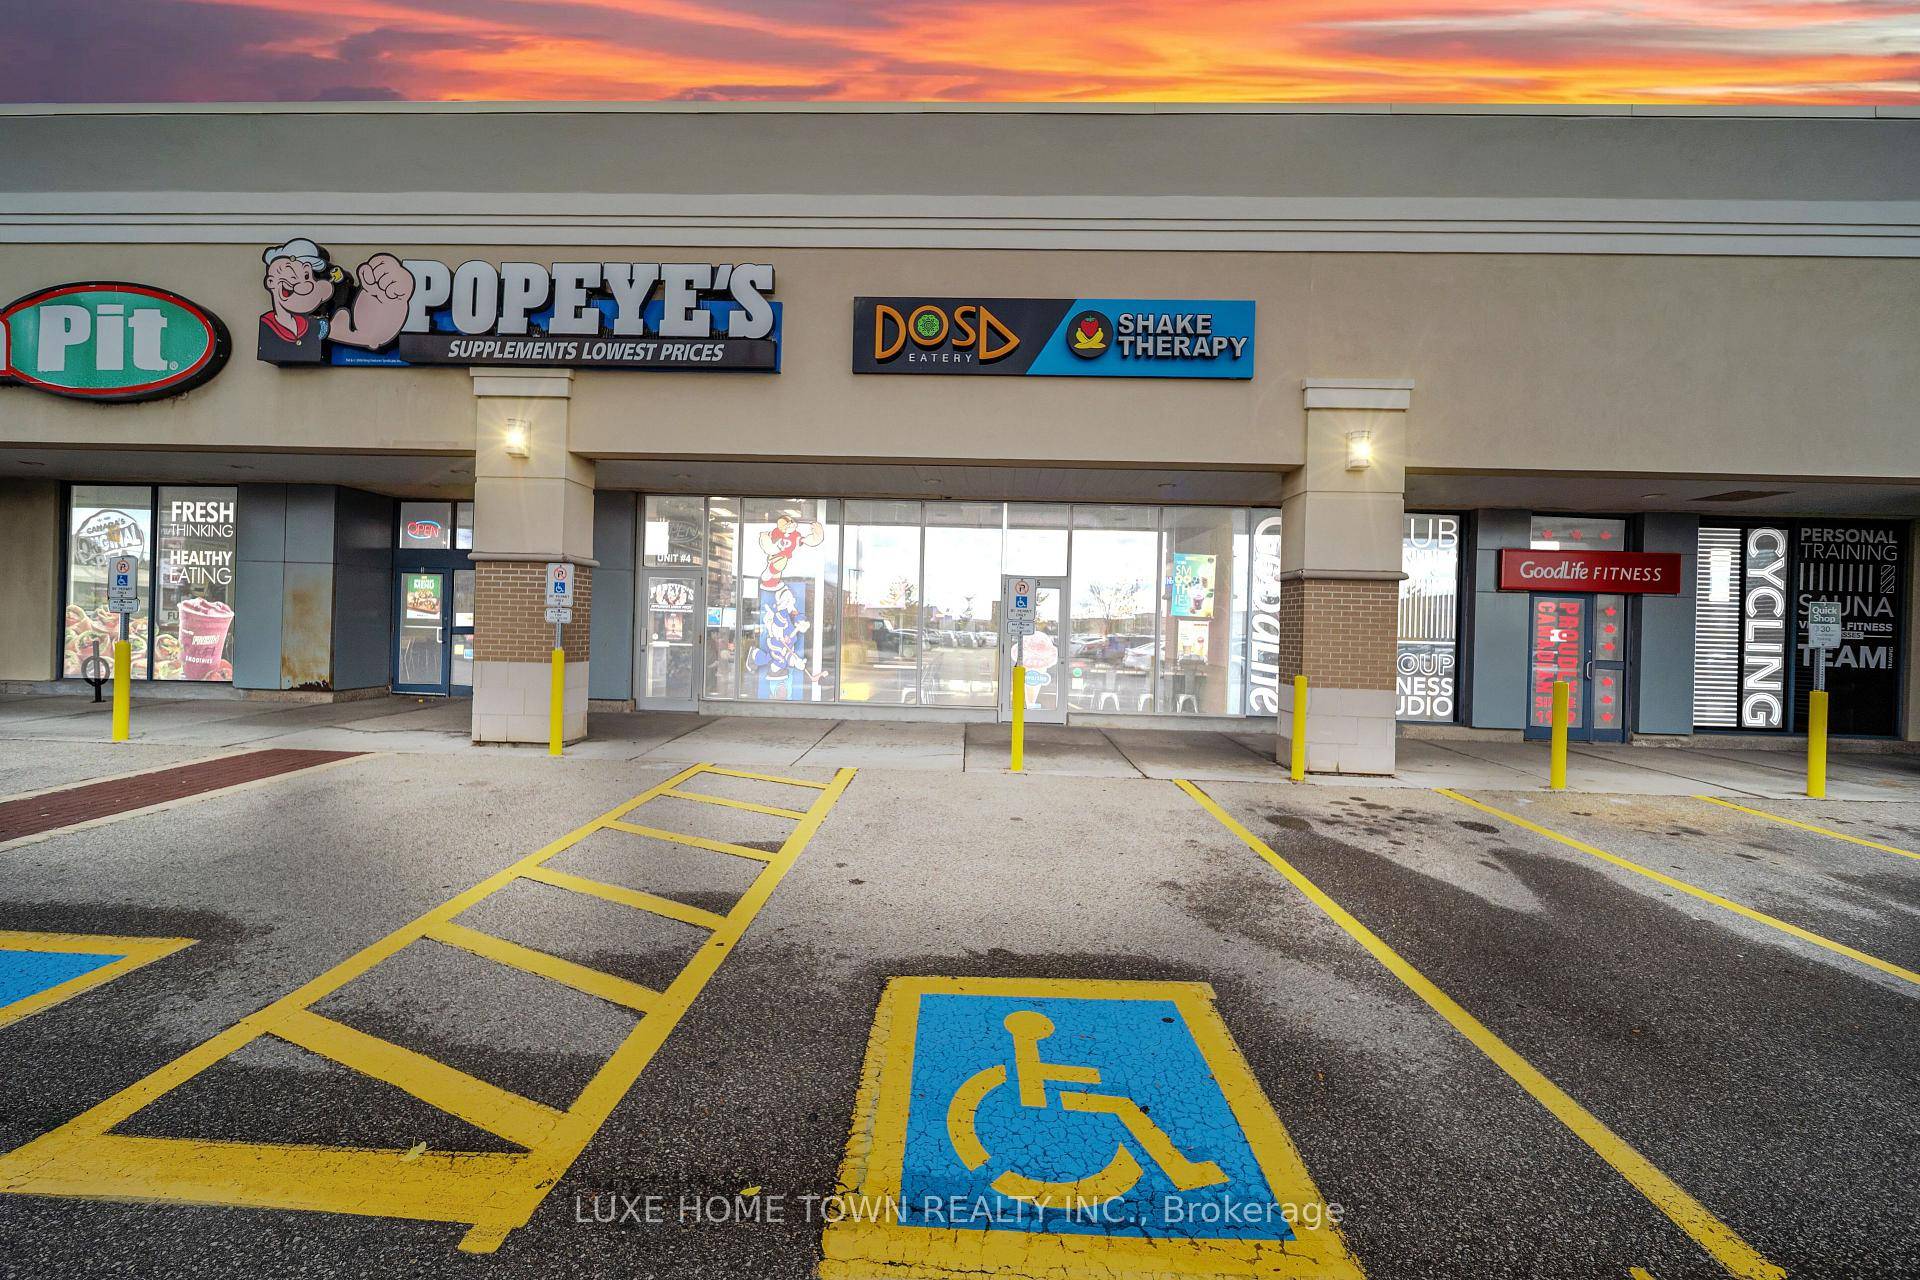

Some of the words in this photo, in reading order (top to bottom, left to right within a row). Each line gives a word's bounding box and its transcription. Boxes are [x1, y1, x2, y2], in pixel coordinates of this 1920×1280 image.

[401, 259, 775, 339] POPEYE'S
[875, 305, 1020, 360] DOSA
[1118, 313, 1212, 334] SHAKE
[448, 340, 577, 360] SUPPLEMENTS
[582, 342, 658, 361] LOWEST
[660, 343, 725, 362] PRICES
[1118, 336, 1247, 357] THERAPY
[909, 353, 972, 363] EATERY
[171, 501, 234, 524] FRESH
[170, 524, 234, 538] THINKING
[407, 521, 439, 538] OPEN
[1408, 518, 1457, 549] UB
[1801, 527, 1898, 544] PERSONAL
[169, 550, 233, 566] HEALTHY
[657, 554, 679, 563] UNIT
[680, 554, 692, 563] #4
[1801, 543, 1897, 561] TRAINING
[169, 566, 232, 585] EATING
[1520, 561, 1589, 580] GoodLife
[1593, 567, 1662, 581] FITNESS
[649, 583, 695, 601] POPEYE'S
[1812, 606, 1838, 615] Quick
[1813, 614, 1836, 623] Shop
[1742, 527, 1786, 727] CYCLING
[1820, 625, 1831, 633] 30
[1846, 622, 1893, 632] FITNESS
[1535, 601, 1556, 693] CANADIAN
[1797, 644, 1887, 669] TEAM
